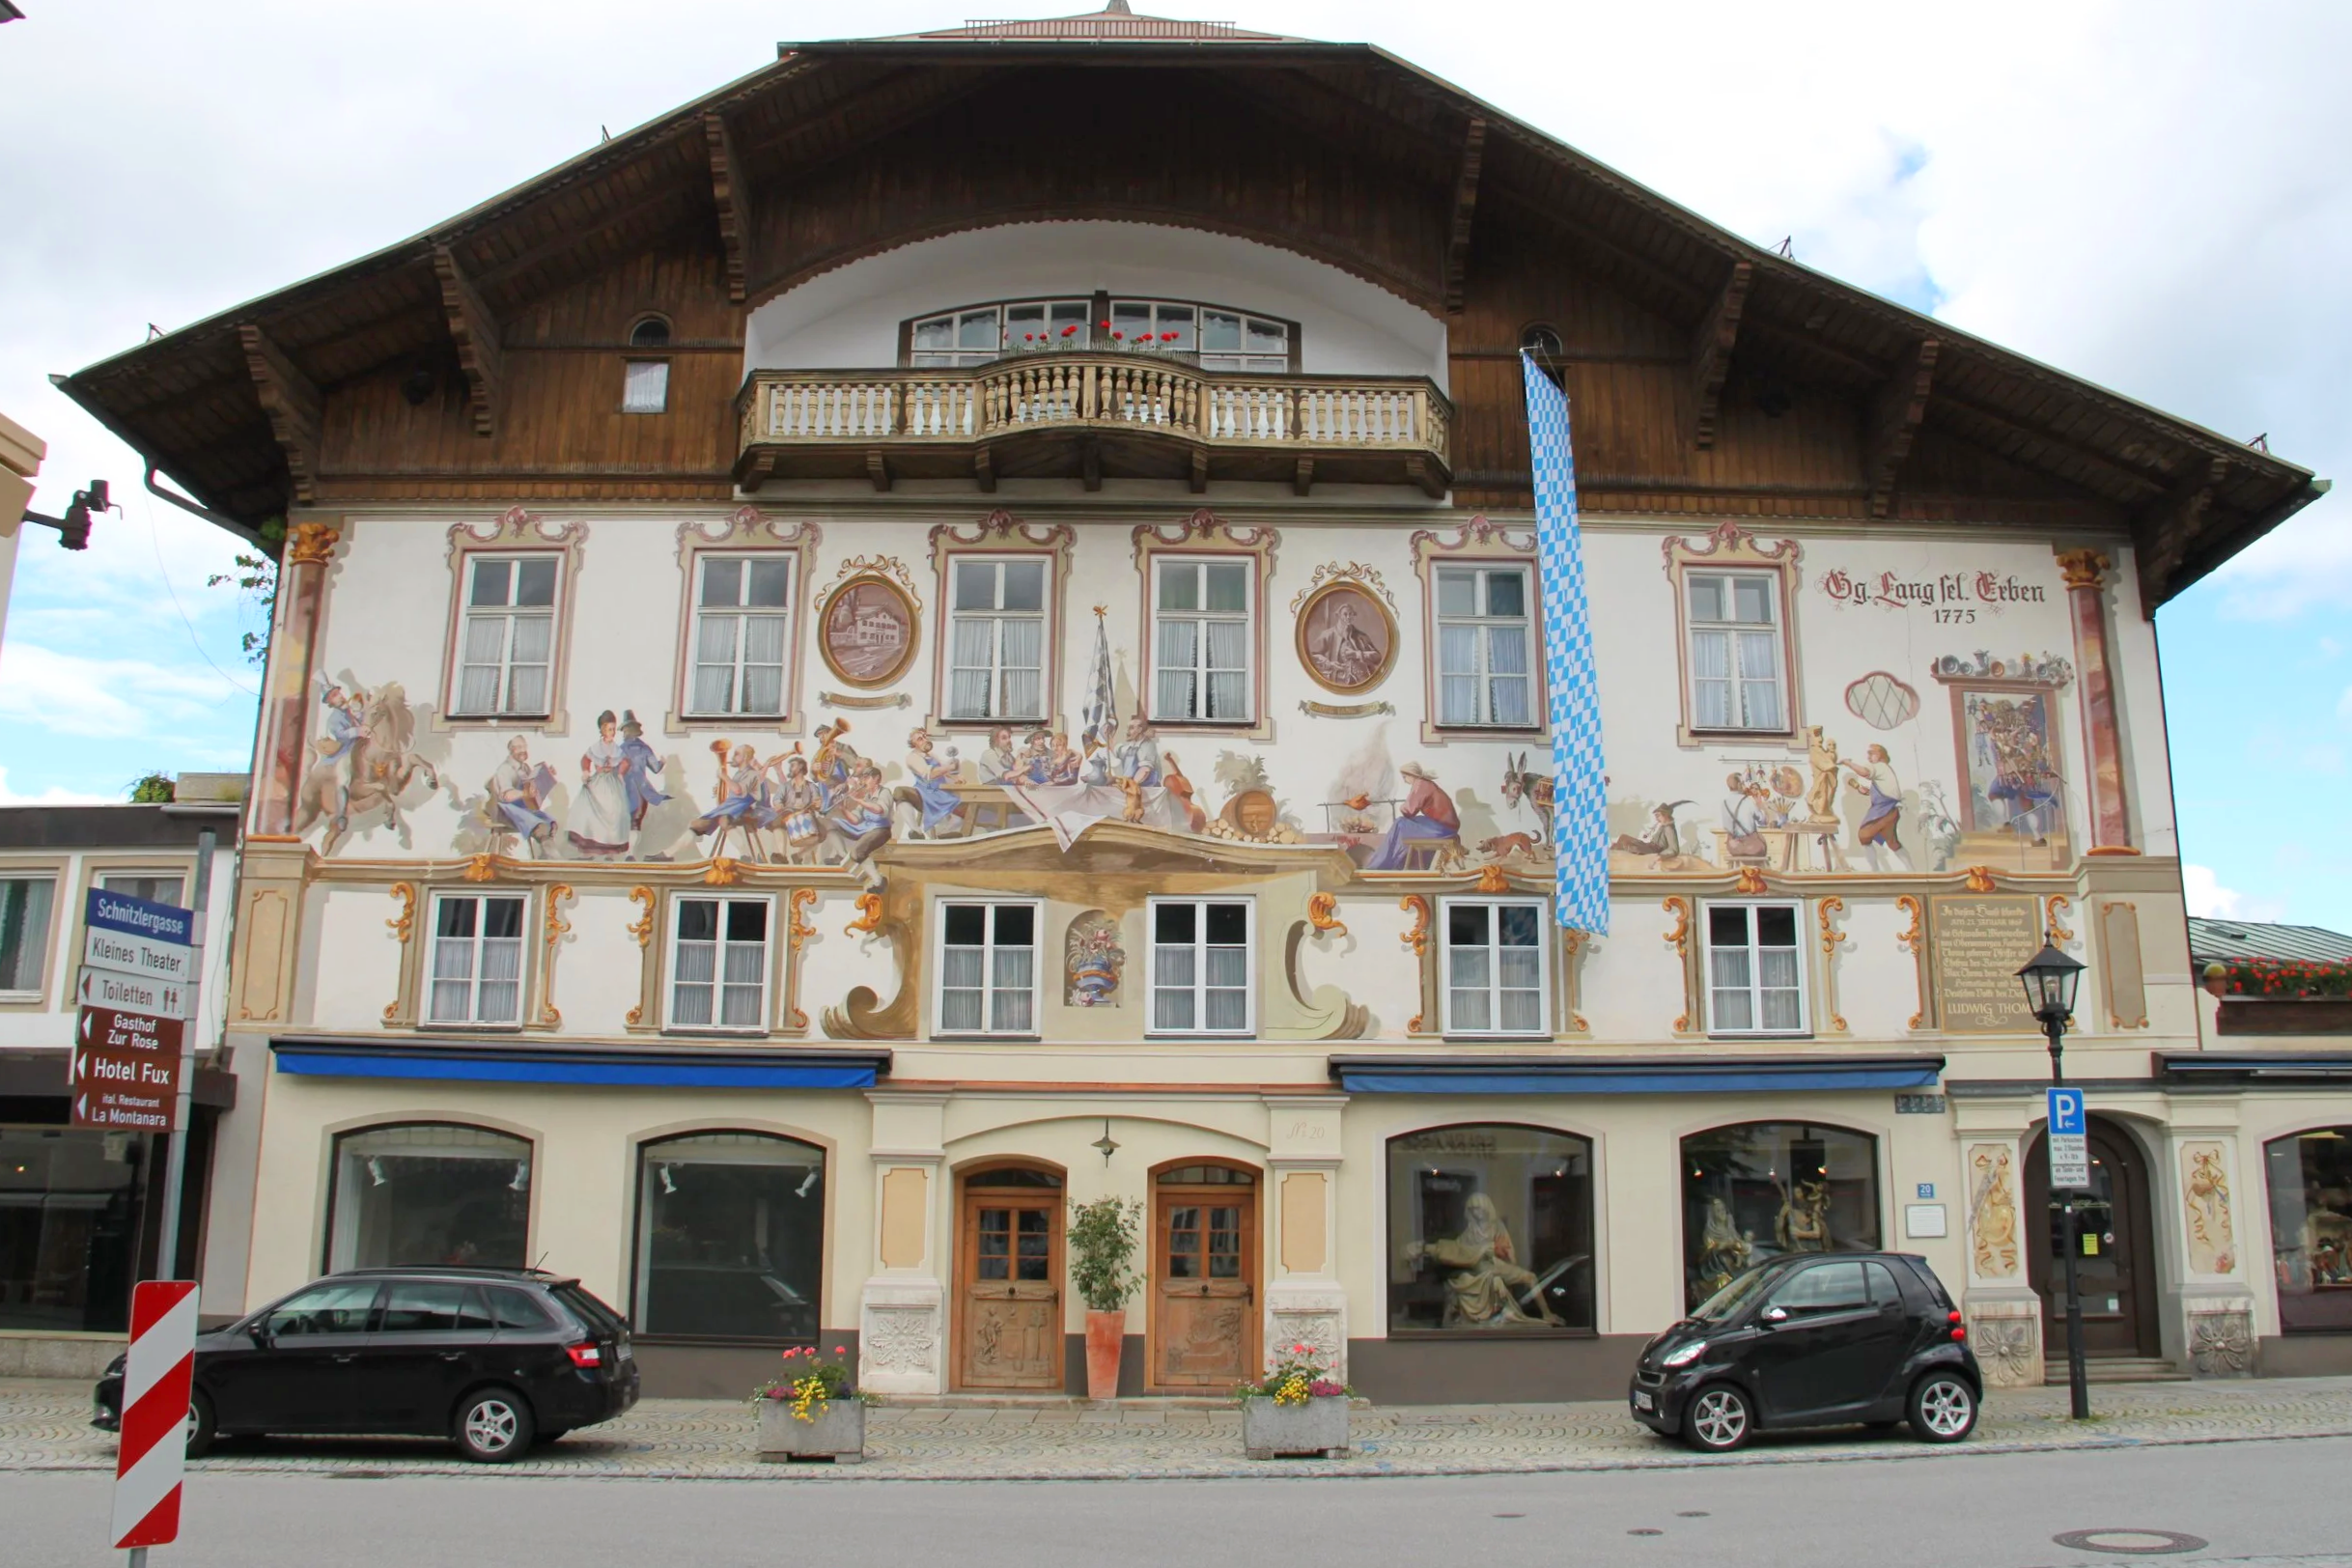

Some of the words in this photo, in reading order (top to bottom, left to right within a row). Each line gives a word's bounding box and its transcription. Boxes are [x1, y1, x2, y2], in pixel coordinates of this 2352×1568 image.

[1873, 570, 1935, 607] Lang
[1975, 569, 2046, 602] Erben
[1932, 609, 1975, 624] 1775
[98, 898, 183, 935] Schnitzlergasse
[92, 937, 134, 964] Kleines
[141, 946, 182, 972] Theater
[102, 980, 153, 1006] Toiletten
[1947, 1002, 1993, 1016] LUDWIG
[114, 1014, 156, 1033] Gasthof
[107, 1029, 127, 1045] Zur
[131, 1033, 158, 1050] Rose
[94, 1057, 136, 1080] Hotel
[142, 1063, 170, 1084] Fux
[101, 1093, 117, 1105] ital.
[118, 1095, 159, 1108] Restaurant
[92, 1106, 106, 1122] La
[109, 1108, 167, 1127] Montanara
[2056, 1094, 2075, 1129] P
[1309, 1126, 1326, 1139] 20
[1919, 1184, 1931, 1193] 20
